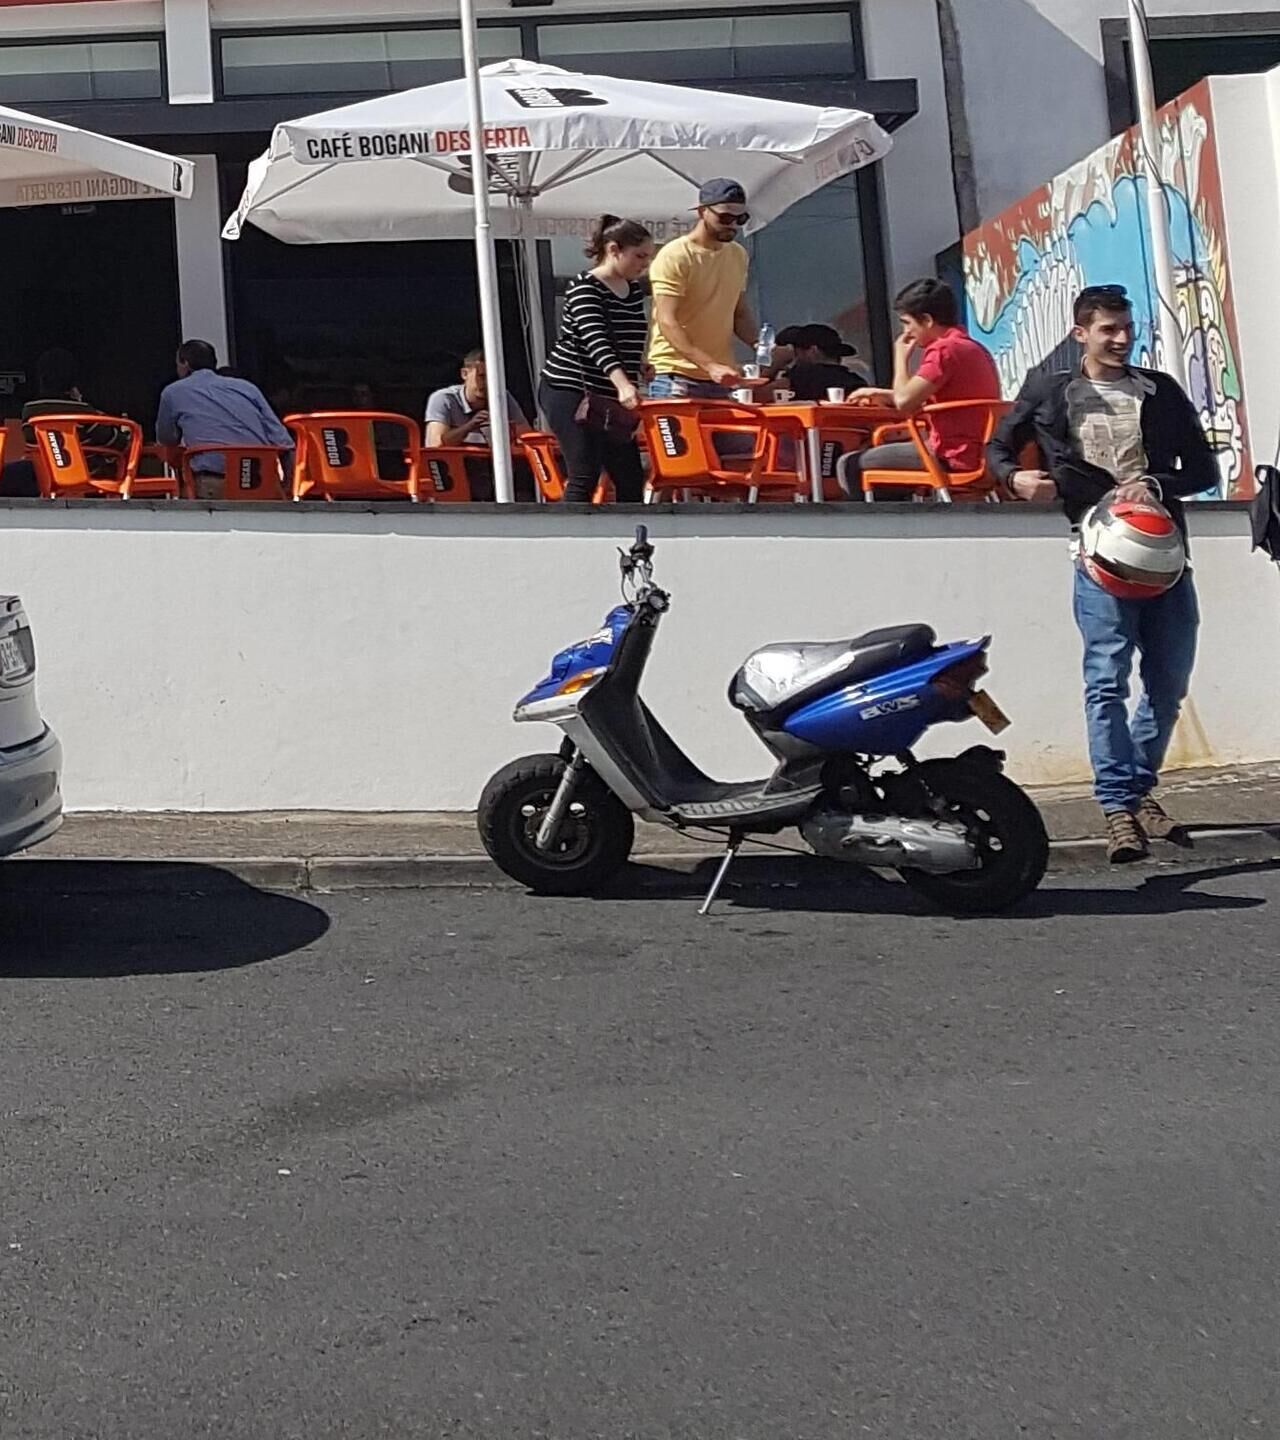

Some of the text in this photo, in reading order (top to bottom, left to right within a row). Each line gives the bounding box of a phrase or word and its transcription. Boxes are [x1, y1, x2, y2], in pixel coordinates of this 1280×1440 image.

[17, 126, 59, 154] DESPERTA
[306, 126, 532, 159] CAFÉ BOGANI DESERTA
[47, 430, 65, 467] BOGANI
[324, 429, 341, 466] BOGANI
[657, 418, 677, 456] BOGANI
